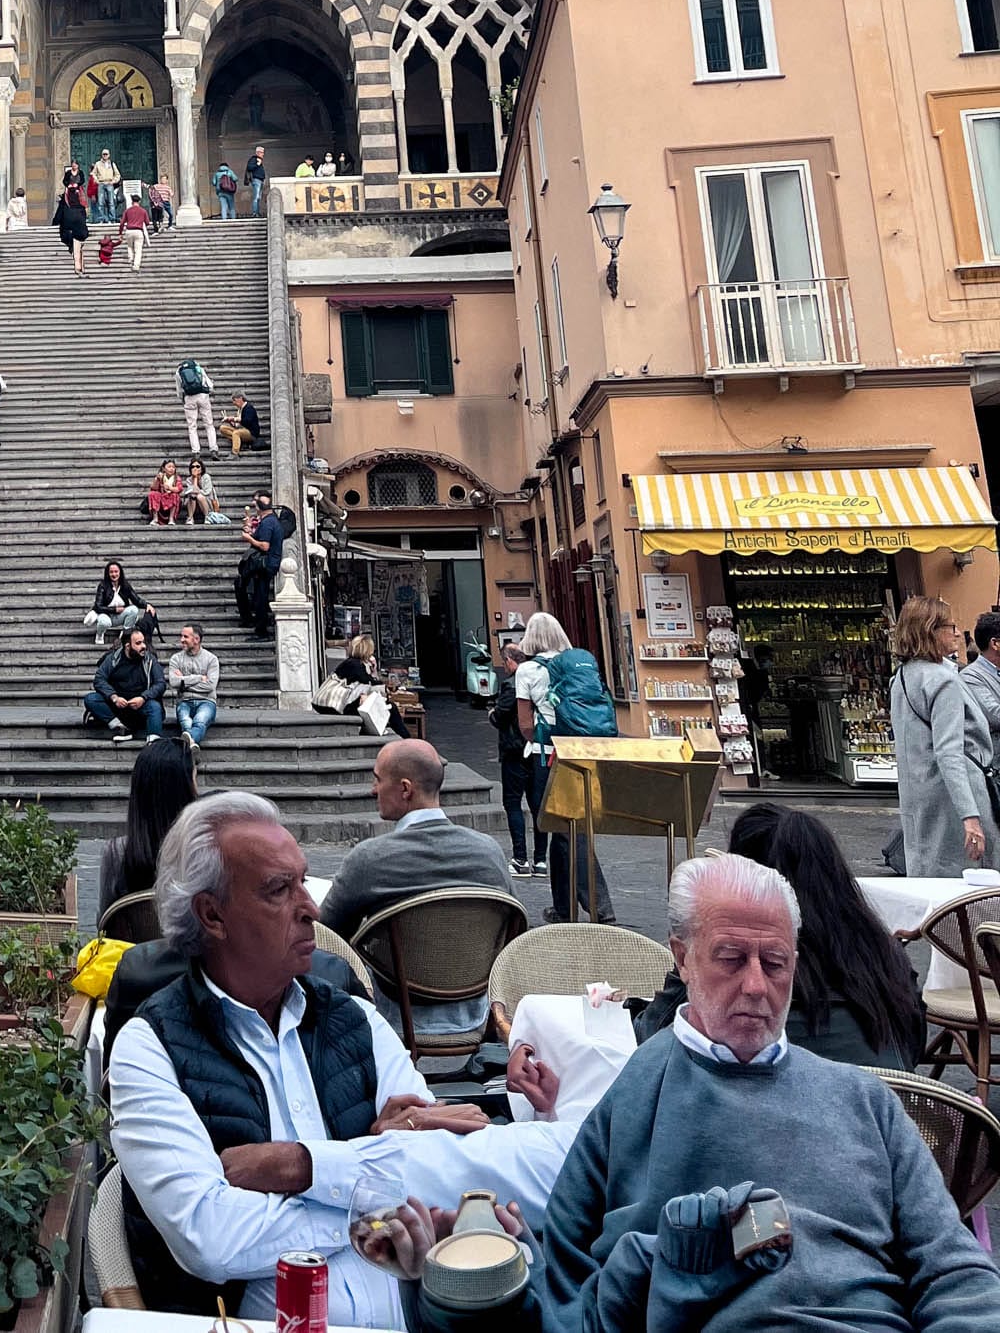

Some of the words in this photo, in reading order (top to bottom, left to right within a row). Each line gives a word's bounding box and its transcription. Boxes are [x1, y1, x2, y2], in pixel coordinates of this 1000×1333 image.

[764, 497, 870, 508] Limoncello
[724, 530, 778, 548] Antichi
[785, 529, 840, 550] Sapori
[848, 529, 911, 547] d'Amalfi
